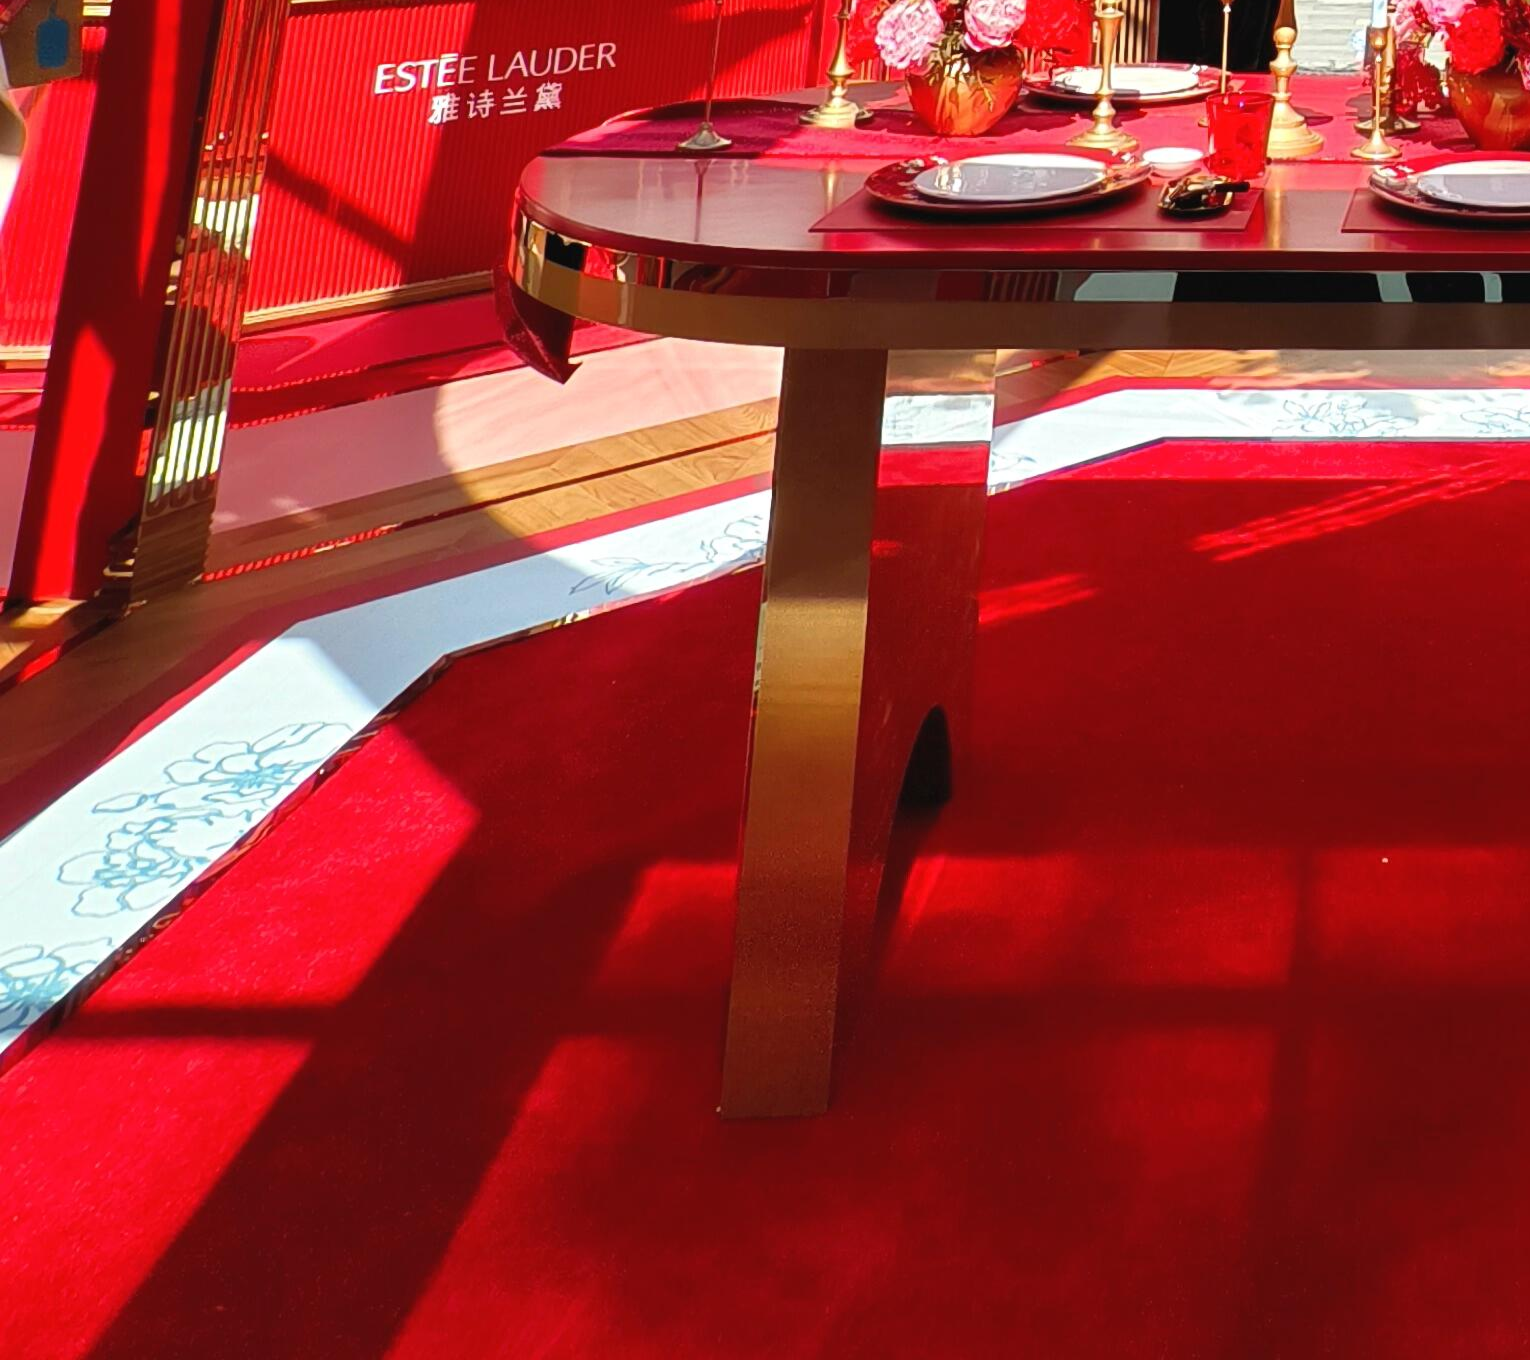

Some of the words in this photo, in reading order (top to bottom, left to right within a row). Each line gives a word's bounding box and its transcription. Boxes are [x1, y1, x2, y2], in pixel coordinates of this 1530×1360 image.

[487, 42, 617, 82] LAUDER
[427, 81, 563, 125] 雅诗兰黛
